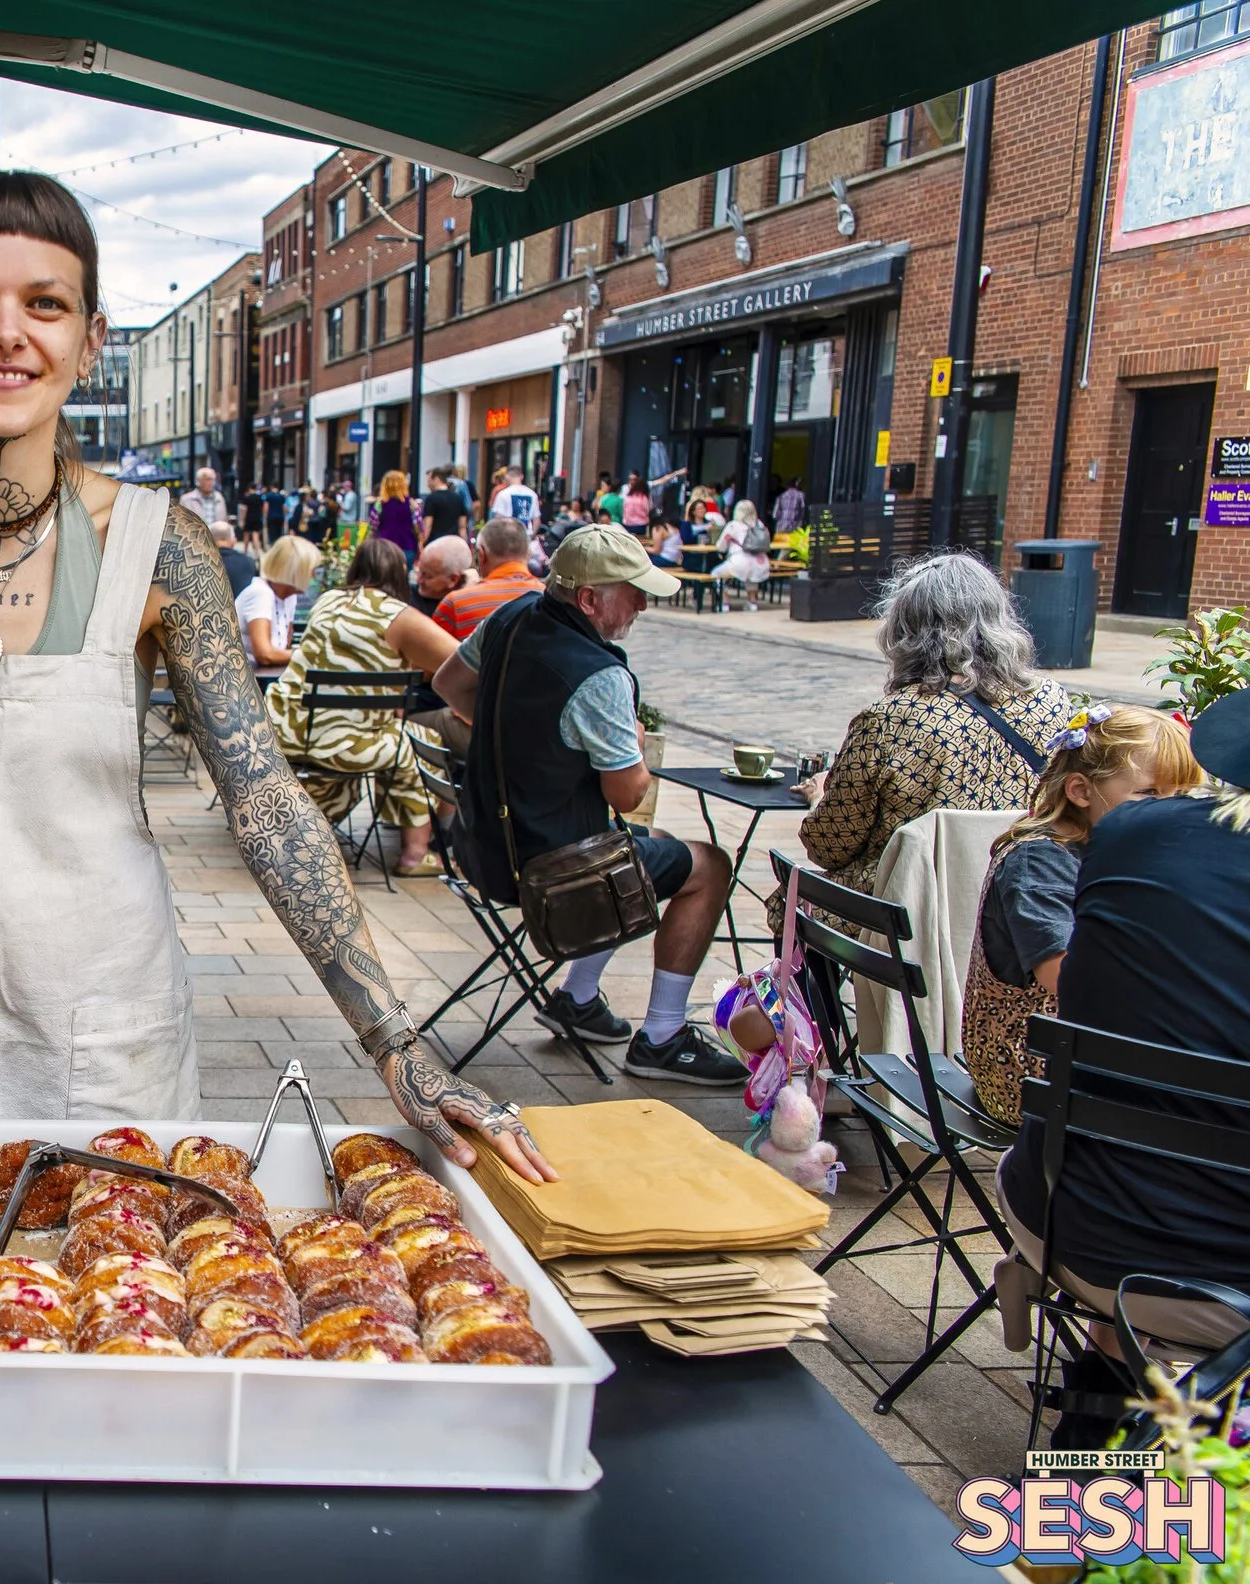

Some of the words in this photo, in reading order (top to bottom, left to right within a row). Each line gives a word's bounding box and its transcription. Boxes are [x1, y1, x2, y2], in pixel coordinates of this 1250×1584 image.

[1161, 112, 1236, 175] THE
[636, 312, 685, 338] HUMBER
[689, 299, 739, 327] STREET
[743, 281, 813, 314] GALLERY
[1221, 440, 1250, 457] Sco
[1210, 490, 1236, 502] Haller
